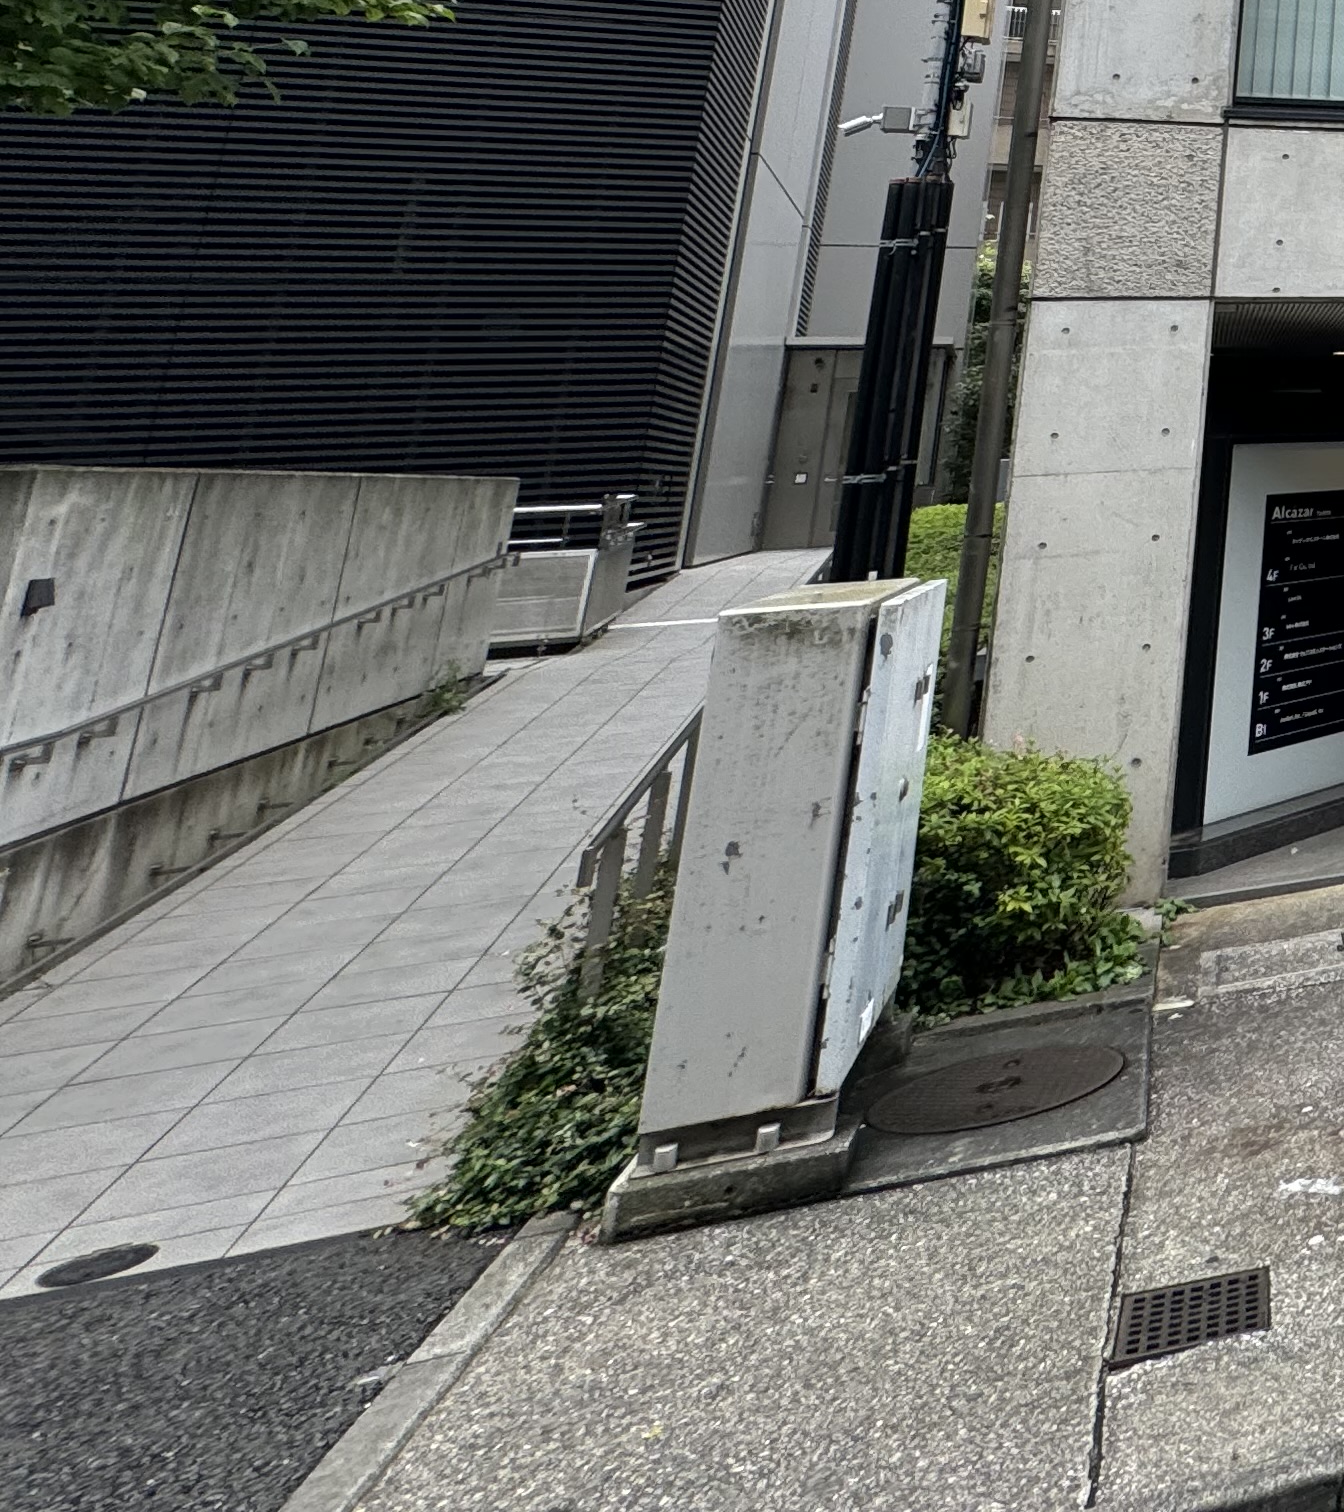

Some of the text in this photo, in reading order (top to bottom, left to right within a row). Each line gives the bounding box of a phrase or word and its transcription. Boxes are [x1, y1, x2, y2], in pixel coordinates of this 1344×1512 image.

[1266, 568, 1279, 582] 4F
[1261, 626, 1276, 641] 3F
[1259, 658, 1273, 673] 2F
[1258, 690, 1270, 704] 1F
[1255, 723, 1267, 737] B1
